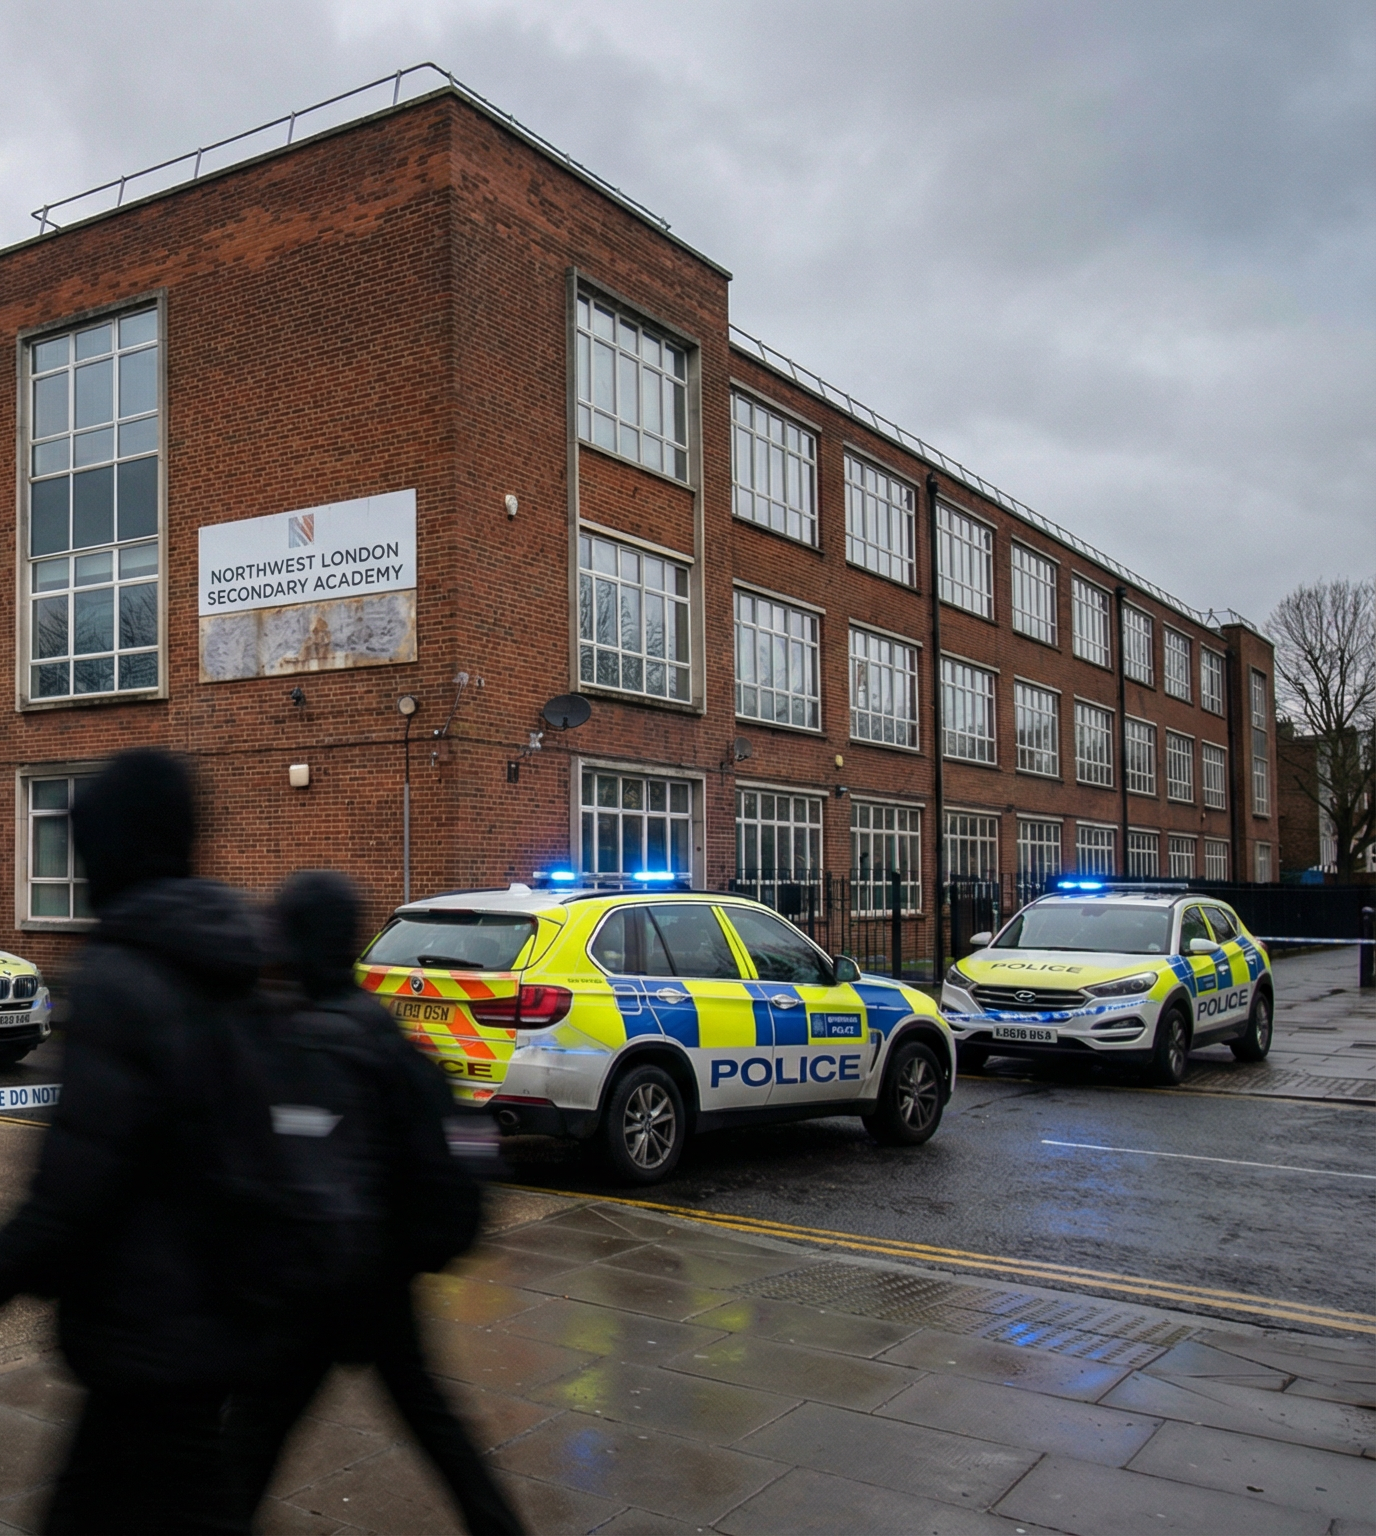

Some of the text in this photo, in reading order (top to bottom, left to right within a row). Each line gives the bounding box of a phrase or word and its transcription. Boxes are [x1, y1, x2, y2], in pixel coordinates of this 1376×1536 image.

[211, 542, 399, 585] NORTHWEST LONDON
[207, 564, 403, 606] SECONDARY ACADEMY
[990, 963, 1083, 974] POLICE
[1197, 989, 1248, 1021] POLICE
[711, 1054, 861, 1088] POLICE
[10, 1089, 28, 1105] DO
[32, 1087, 58, 1103] NOT
